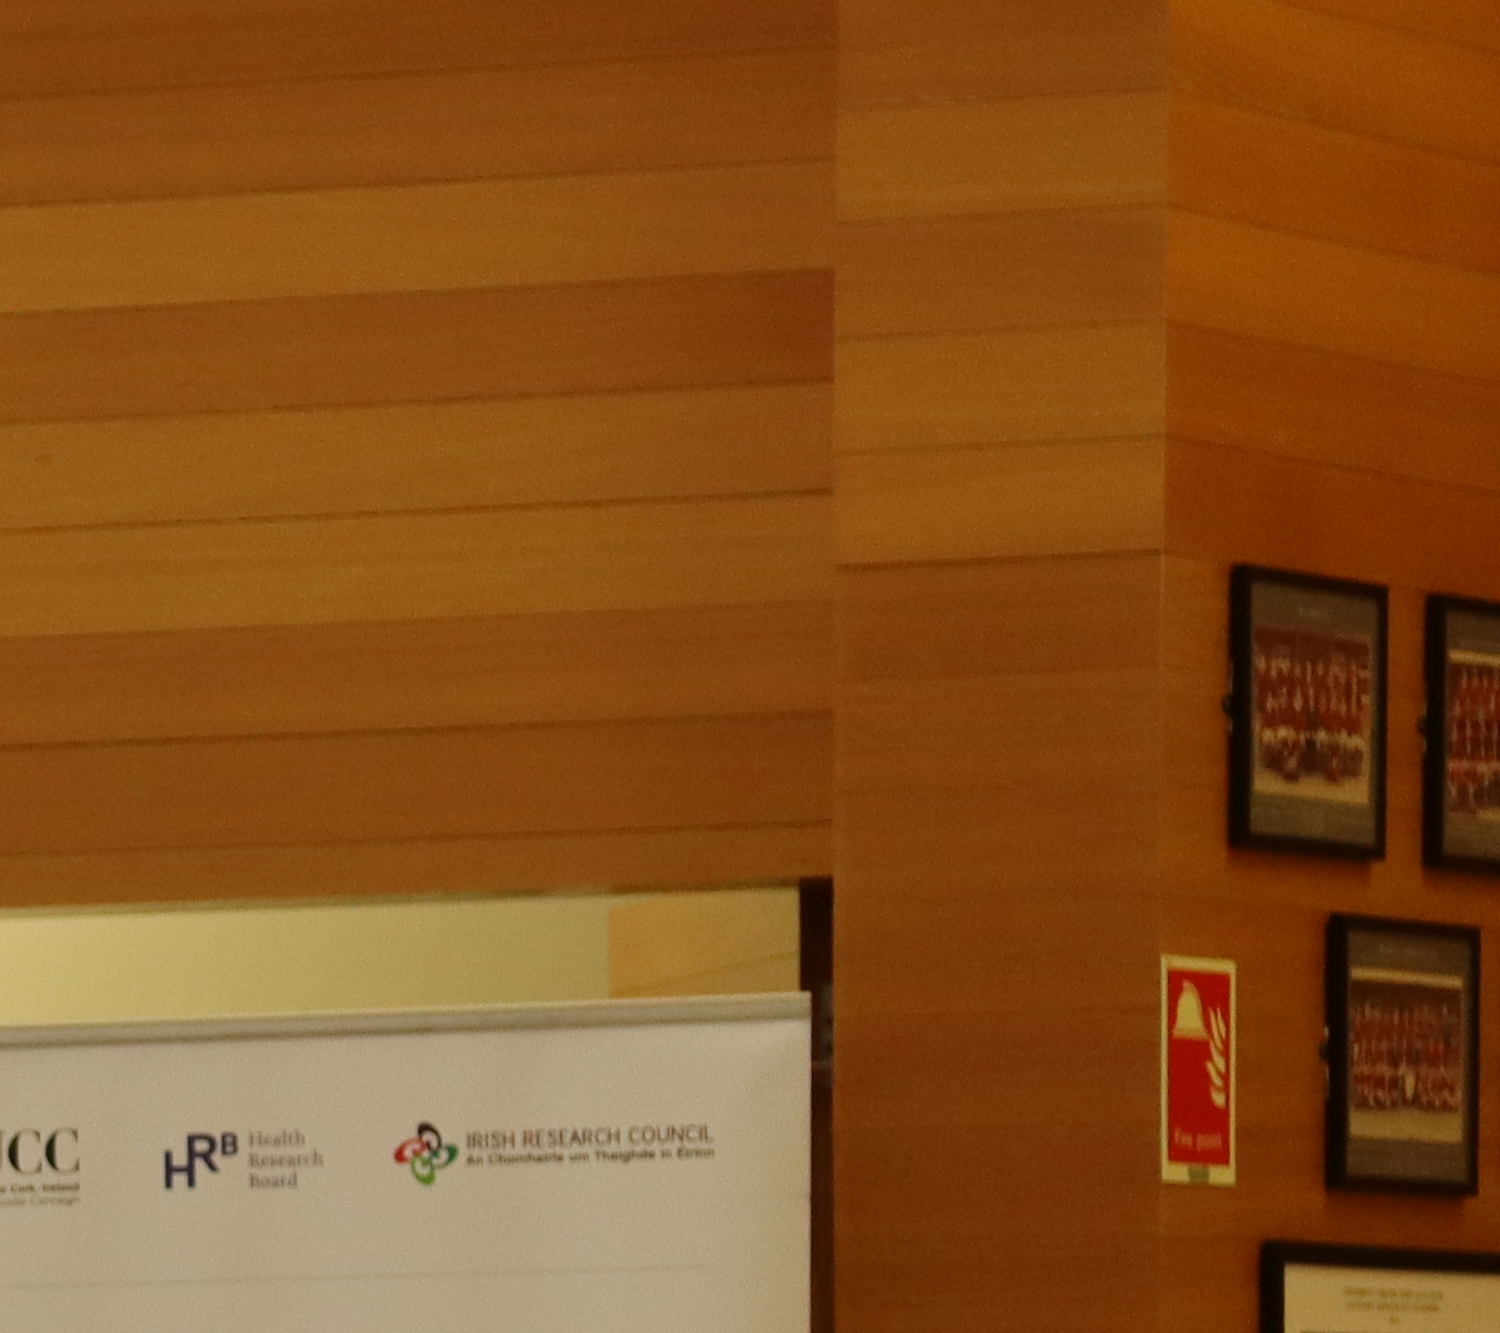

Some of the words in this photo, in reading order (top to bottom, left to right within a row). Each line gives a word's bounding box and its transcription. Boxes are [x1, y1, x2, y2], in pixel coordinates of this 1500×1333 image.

[249, 1129, 306, 1146] Health
[466, 1130, 516, 1149] IRISH
[522, 1127, 621, 1148] RESEARCH
[628, 1124, 714, 1144] COUNCIL
[164, 1132, 239, 1189] HRB
[249, 1149, 324, 1167] Research
[249, 1171, 298, 1189] Board
